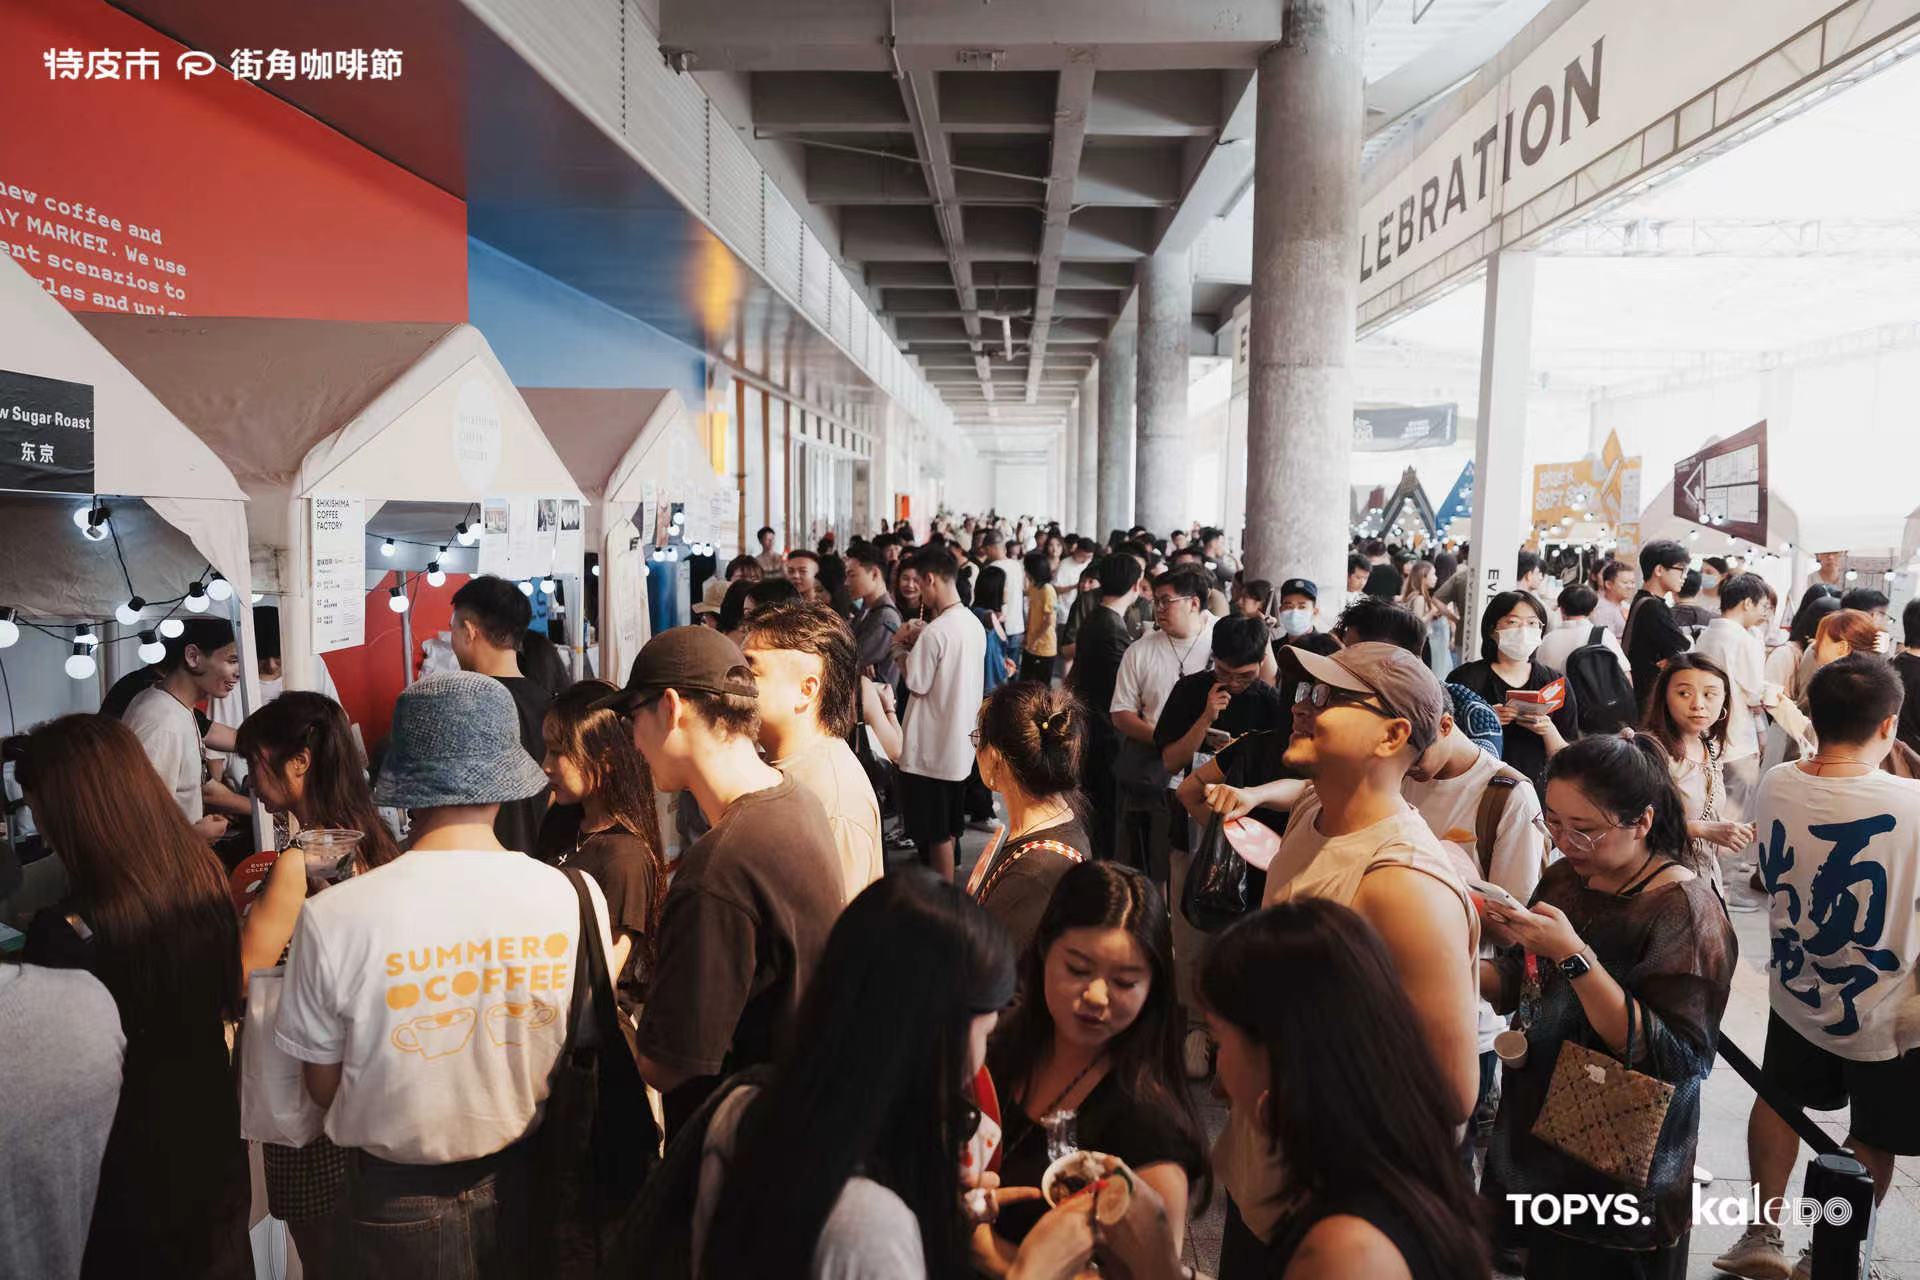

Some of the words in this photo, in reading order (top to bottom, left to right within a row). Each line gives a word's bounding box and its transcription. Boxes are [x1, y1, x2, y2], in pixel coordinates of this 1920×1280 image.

[1360, 34, 1606, 283] LEBRATION
[44, 197, 122, 232] coffee
[128, 224, 162, 245] and
[26, 215, 117, 257] MARKET.
[124, 245, 149, 266] We
[153, 255, 187, 277] use
[35, 277, 86, 302] les
[92, 291, 129, 312] and
[47, 254, 160, 294] scenarios
[164, 281, 186, 300] to
[12, 405, 52, 426] Sugar
[55, 411, 90, 430] Roast
[21, 441, 55, 464] 东京
[316, 510, 339, 519] COFFEE
[316, 521, 343, 531] FACTORY
[424, 963, 567, 1002] COFFEE
